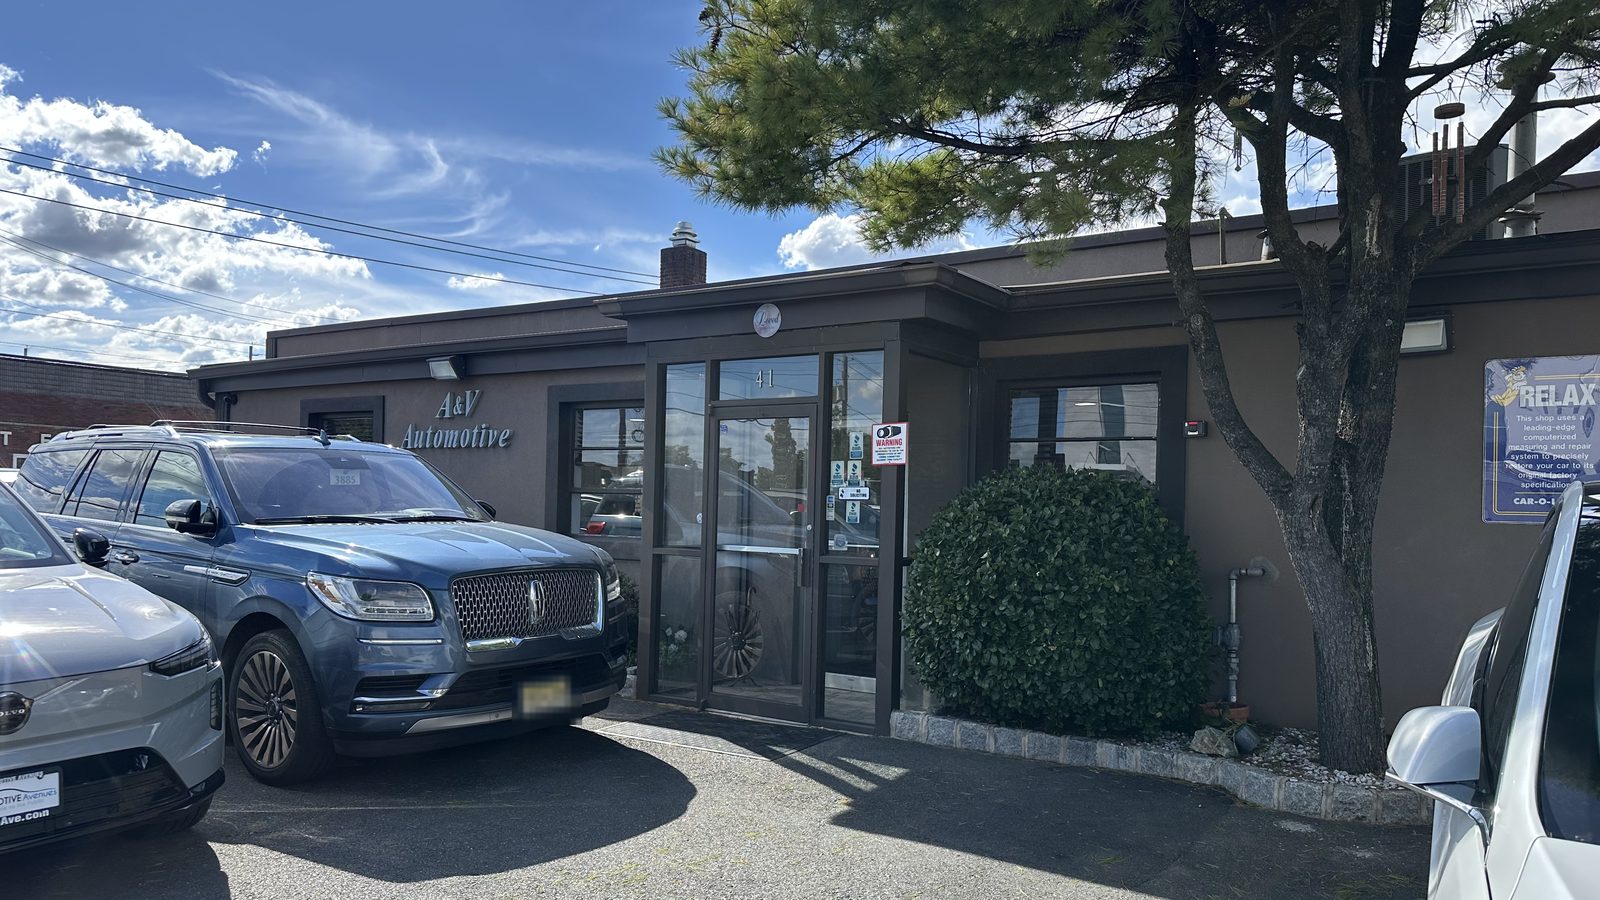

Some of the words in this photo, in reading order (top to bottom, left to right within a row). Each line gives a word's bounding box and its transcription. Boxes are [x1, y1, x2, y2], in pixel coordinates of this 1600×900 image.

[755, 369, 774, 388] 41
[1519, 383, 1596, 407] RELAX
[435, 389, 481, 418] A&V
[1535, 415, 1554, 423] shop
[1523, 424, 1576, 432] leading-edge
[401, 423, 511, 449] Automotive
[1523, 434, 1577, 442] computerized
[876, 438, 903, 447] WARNING
[1508, 443, 1548, 451] measuring
[1568, 442, 1592, 451] repair
[1510, 453, 1539, 461] system
[1553, 452, 1589, 461] precisely
[335, 475, 356, 484] 3885
[1521, 481, 1570, 489] specification
[23, 789, 57, 801] Avenues
